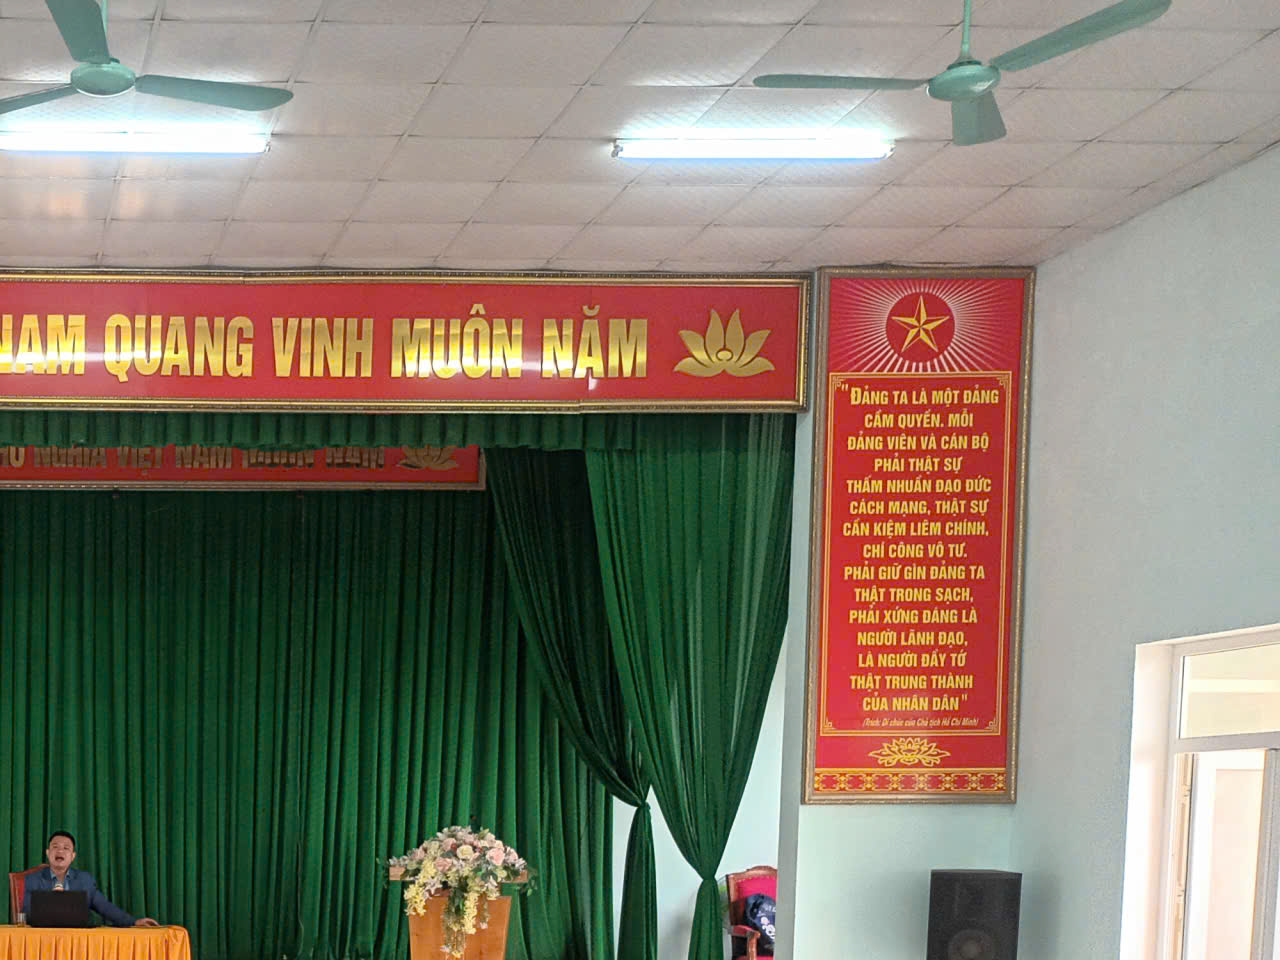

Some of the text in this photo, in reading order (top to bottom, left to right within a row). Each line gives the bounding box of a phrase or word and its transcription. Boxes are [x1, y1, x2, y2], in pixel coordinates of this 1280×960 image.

[104, 313, 254, 383] QUANG
[271, 317, 373, 378] VINH
[390, 304, 524, 379] MUÔN
[541, 304, 648, 379] NĂM
[892, 390, 908, 404] TA
[912, 386, 928, 404] LÀ
[932, 386, 960, 407] MỘT
[964, 384, 998, 404] ĐẢNG
[848, 429, 988, 453] ĐẢNG VIÊN VÀ CÁN BỘ
[875, 452, 962, 474] PHẢI THẬT SỰ
[846, 474, 882, 493] THẤM
[936, 479, 961, 496] ĐẠO
[966, 476, 991, 493] ĐỨC
[850, 498, 884, 514] CÁCH
[935, 498, 966, 517] THẬT
[970, 500, 988, 517] SỰ
[874, 519, 906, 539] KIỆM
[910, 519, 941, 536] LIÊM
[863, 541, 884, 558] CHÍ
[889, 541, 924, 558] CÔNG
[928, 541, 944, 558] VÔ
[844, 560, 984, 580] PHẢI GIỮ GÌN ĐẢNG TA
[854, 585, 886, 604] THẬT
[889, 588, 931, 602] TRONG
[850, 604, 977, 624] PHẢI XỨNG ĐÁNG LÀ
[858, 628, 896, 645] NGƯỜI
[901, 628, 934, 645] LÃNH
[859, 651, 874, 667] LÀ
[878, 651, 917, 667] NGƯỜI
[951, 651, 965, 667] TỚ
[849, 672, 973, 691] THẬT TRUNG THÀNH
[863, 692, 888, 711] CỦA
[892, 694, 929, 711] NHÂN
